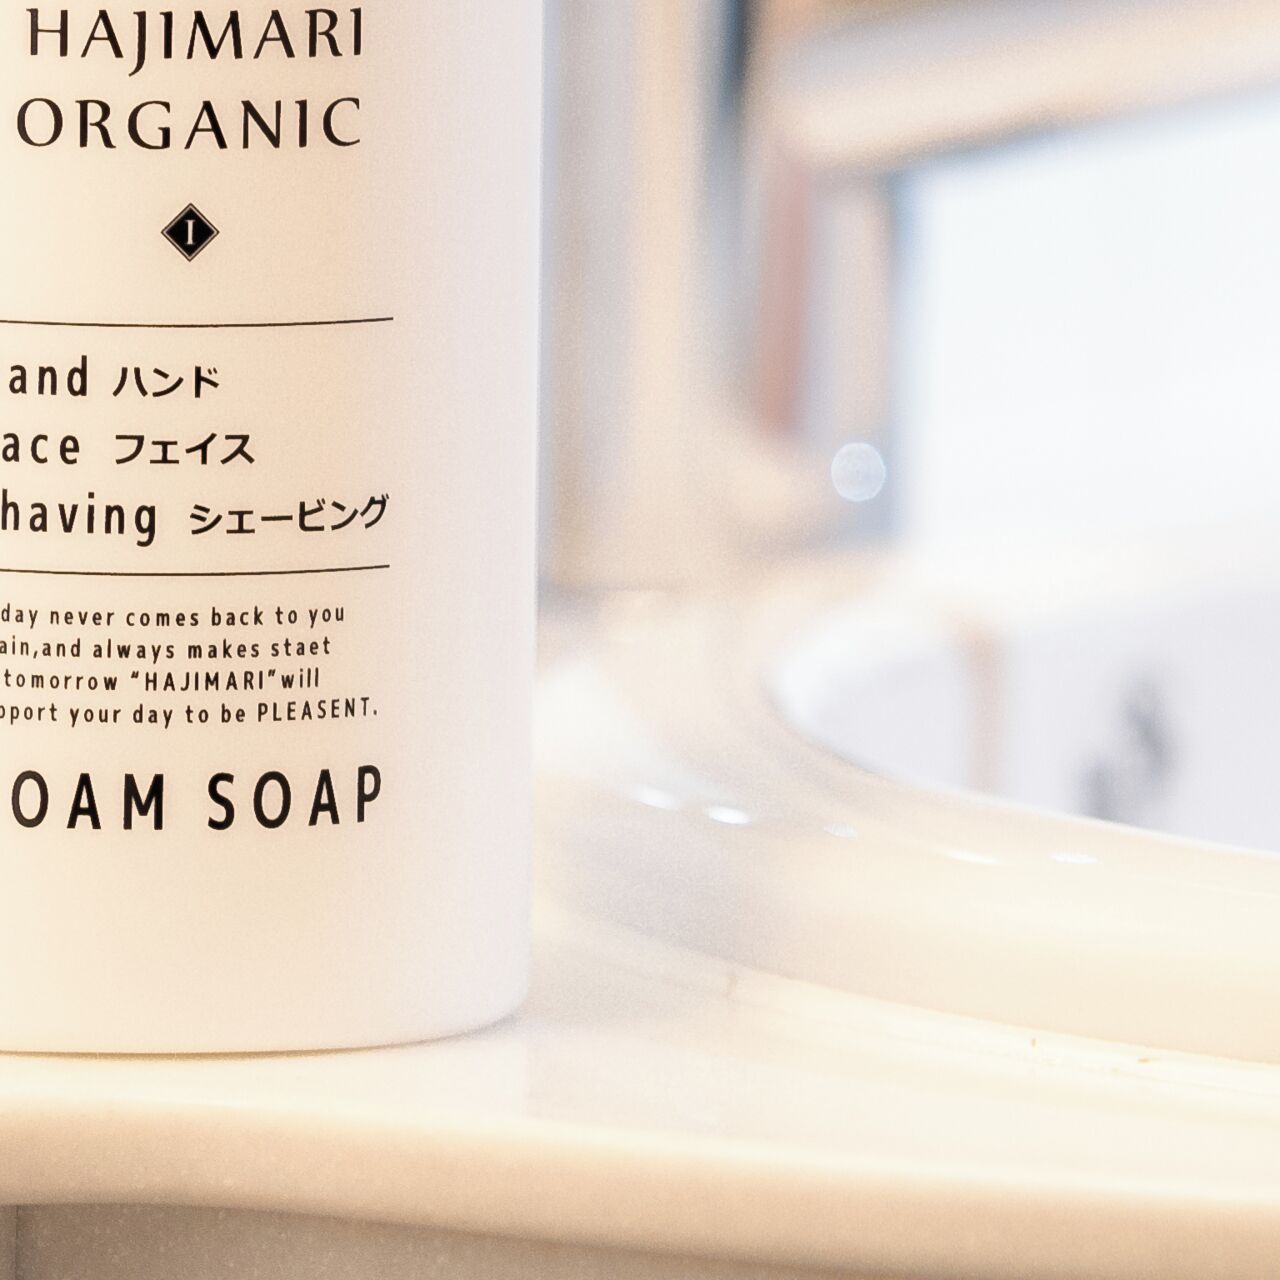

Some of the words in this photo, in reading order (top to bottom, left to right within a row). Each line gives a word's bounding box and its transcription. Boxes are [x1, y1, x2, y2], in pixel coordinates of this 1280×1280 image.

[26, 7, 361, 77] HAJIMARI
[17, 97, 360, 150] ORGANIC
[112, 365, 219, 398] ハンド
[115, 432, 255, 465] フェイス
[190, 493, 389, 535] シェービング
[50, 610, 115, 626] never
[126, 612, 199, 627] comes
[211, 605, 263, 626] back
[275, 606, 297, 625] to
[308, 607, 344, 629] you
[93, 638, 174, 664] always
[188, 638, 259, 659] makes
[271, 636, 330, 657] staet
[4, 668, 117, 690] tomorrow
[70, 708, 121, 727] your
[133, 703, 173, 729] day
[185, 705, 209, 723] to
[221, 703, 245, 723] be
[258, 697, 377, 722] PLEASENT.
[208, 765, 381, 830] SOAP
